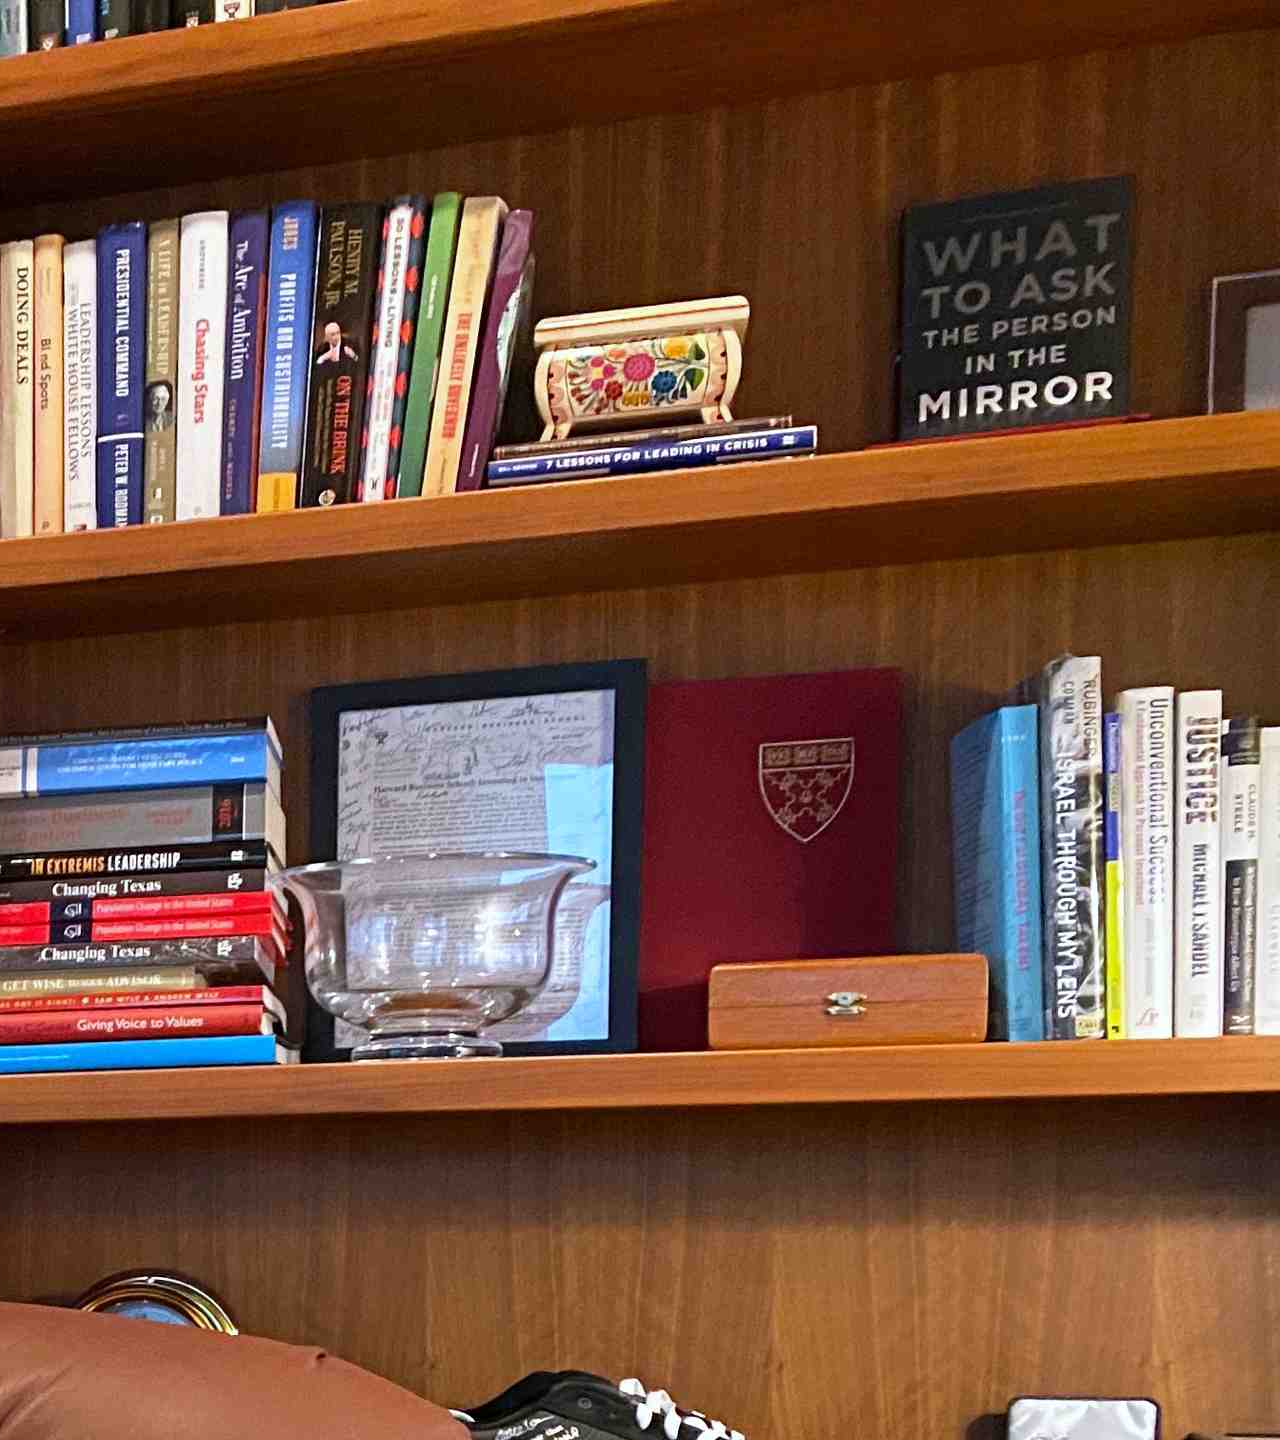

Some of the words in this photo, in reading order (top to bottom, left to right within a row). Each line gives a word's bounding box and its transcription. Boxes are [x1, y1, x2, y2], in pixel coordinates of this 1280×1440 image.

[236, 240, 249, 262] The
[389, 237, 404, 296] LESSONS
[923, 213, 1122, 278] WHAT
[16, 267, 29, 324] DOING
[115, 249, 130, 334] PRESIDENTIAL
[234, 263, 254, 291] Arc
[277, 273, 297, 322] PROFITS
[921, 280, 992, 320] TO
[1009, 261, 1117, 309] ASK
[67, 308, 79, 361] WHITE
[79, 302, 92, 390] LEADERSHIP
[192, 319, 209, 381] Chasing
[230, 306, 252, 380] Ambition
[921, 323, 979, 349] THE
[991, 304, 1116, 340] PERSON
[16, 330, 29, 385] DEALS
[115, 336, 130, 397] COMMAND
[965, 353, 995, 375] IN
[1007, 344, 1067, 369] THE
[39, 373, 52, 411] Spots
[68, 363, 79, 415] HOUSE
[193, 383, 208, 424] Stars
[336, 375, 352, 396] ON
[918, 370, 1115, 423] MIRROR
[79, 395, 92, 459] LESSONS
[333, 399, 349, 428] THE
[67, 418, 79, 482] FELLOWS
[115, 444, 129, 475] PETER
[329, 430, 347, 475] BRINK
[546, 460, 555, 470] 7
[556, 455, 611, 469] LESSONS
[614, 451, 641, 463] FOR
[643, 445, 703, 461] LEADING
[706, 443, 721, 454] IN
[724, 436, 769, 450] CRISIS
[1055, 751, 1076, 826] ISRAEL
[1149, 698, 1169, 829] Unconventional
[1185, 716, 1219, 826] JUSTICE
[1233, 793, 1243, 834] STEELE
[1248, 783, 1256, 823] CLAUDE
[30, 857, 44, 875] IN
[45, 856, 105, 875] EXTREMIS
[106, 852, 181, 872] LEADERSHIP
[51, 882, 118, 899] Changing
[119, 879, 161, 892] Texas
[1055, 828, 1078, 925] THROUGH
[1149, 834, 1169, 906] Success
[1191, 843, 1208, 910] MICHAEL
[39, 945, 105, 962] Changing
[111, 944, 151, 957] Texas
[1056, 929, 1079, 963] MY
[1190, 922, 1208, 979] SANDEL
[2, 979, 29, 994] GET
[31, 978, 64, 991] WISE
[1056, 963, 1079, 1018] LENS
[76, 1018, 114, 1033] Giving
[114, 1016, 148, 1030] Voice
[151, 1018, 163, 1028] to
[164, 1015, 204, 1028] Values
